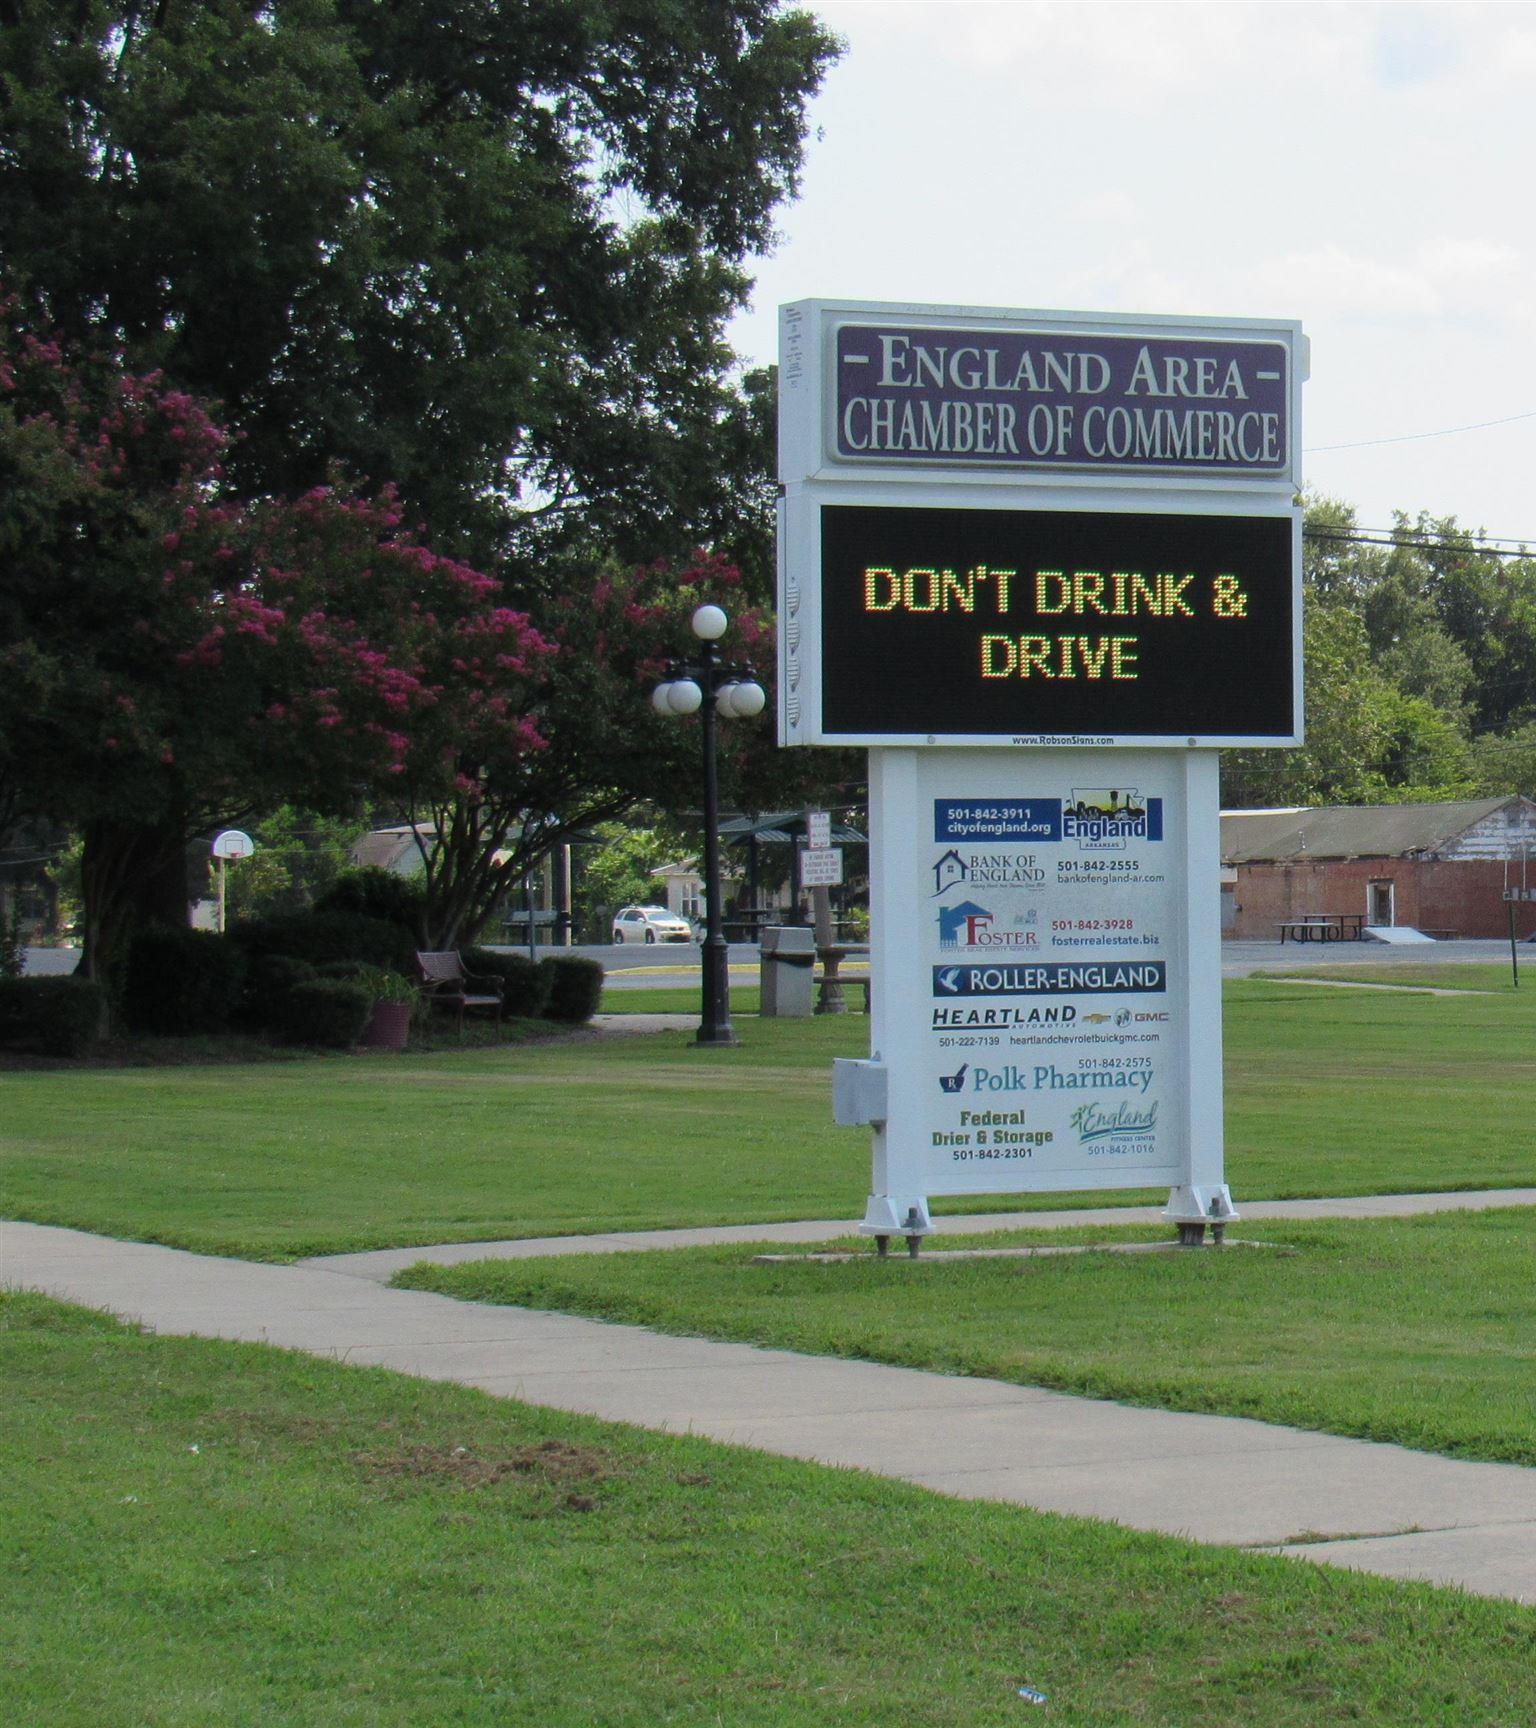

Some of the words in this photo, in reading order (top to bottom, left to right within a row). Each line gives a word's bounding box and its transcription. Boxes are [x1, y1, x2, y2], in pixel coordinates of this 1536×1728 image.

[877, 334, 1111, 395] ENGLAND
[1125, 345, 1249, 399] AREA
[844, 398, 1019, 454] CHAMBER
[1027, 404, 1074, 456] OF
[1083, 406, 1280, 463] COMMERCE
[864, 564, 1016, 613] DON'T
[1035, 571, 1194, 616] DRINK
[1212, 575, 1248, 617] &
[980, 634, 1138, 679] DRIVE
[947, 808, 1031, 819] 501-842-3911
[947, 821, 1051, 835] cityofengland.org
[1063, 816, 1147, 842] England
[970, 855, 1012, 868] BANK
[1016, 855, 1037, 868] OF
[1057, 861, 1139, 871] 501-842-2555
[970, 868, 1045, 881] ENGLAND
[1057, 873, 1165, 885] bankofengland-ar.com
[966, 914, 1038, 945] FOSTER
[1052, 920, 1133, 931] 501-842-3928
[1052, 935, 1159, 947] fosterrealestate.biz
[970, 967, 1159, 991] ROLLER-ENGLAND
[932, 1005, 1077, 1025] HEARTLAND
[1134, 1012, 1169, 1022] GMC
[939, 1036, 1000, 1047] 501-222-7139
[1010, 1032, 1160, 1046] heartlandchevroletbuickgmc.com
[1078, 1057, 1152, 1068] 501-842-2575
[974, 1066, 1027, 1092] Polk
[1034, 1065, 1154, 1094] Pharmacy
[960, 1110, 1025, 1126] Federal
[1083, 1100, 1158, 1132] England
[932, 1131, 971, 1146] Drier
[976, 1130, 987, 1144] &
[993, 1129, 1054, 1147] Storage
[953, 1148, 1032, 1160] 501-842-2301
[1088, 1144, 1154, 1155] 501-842-1016
